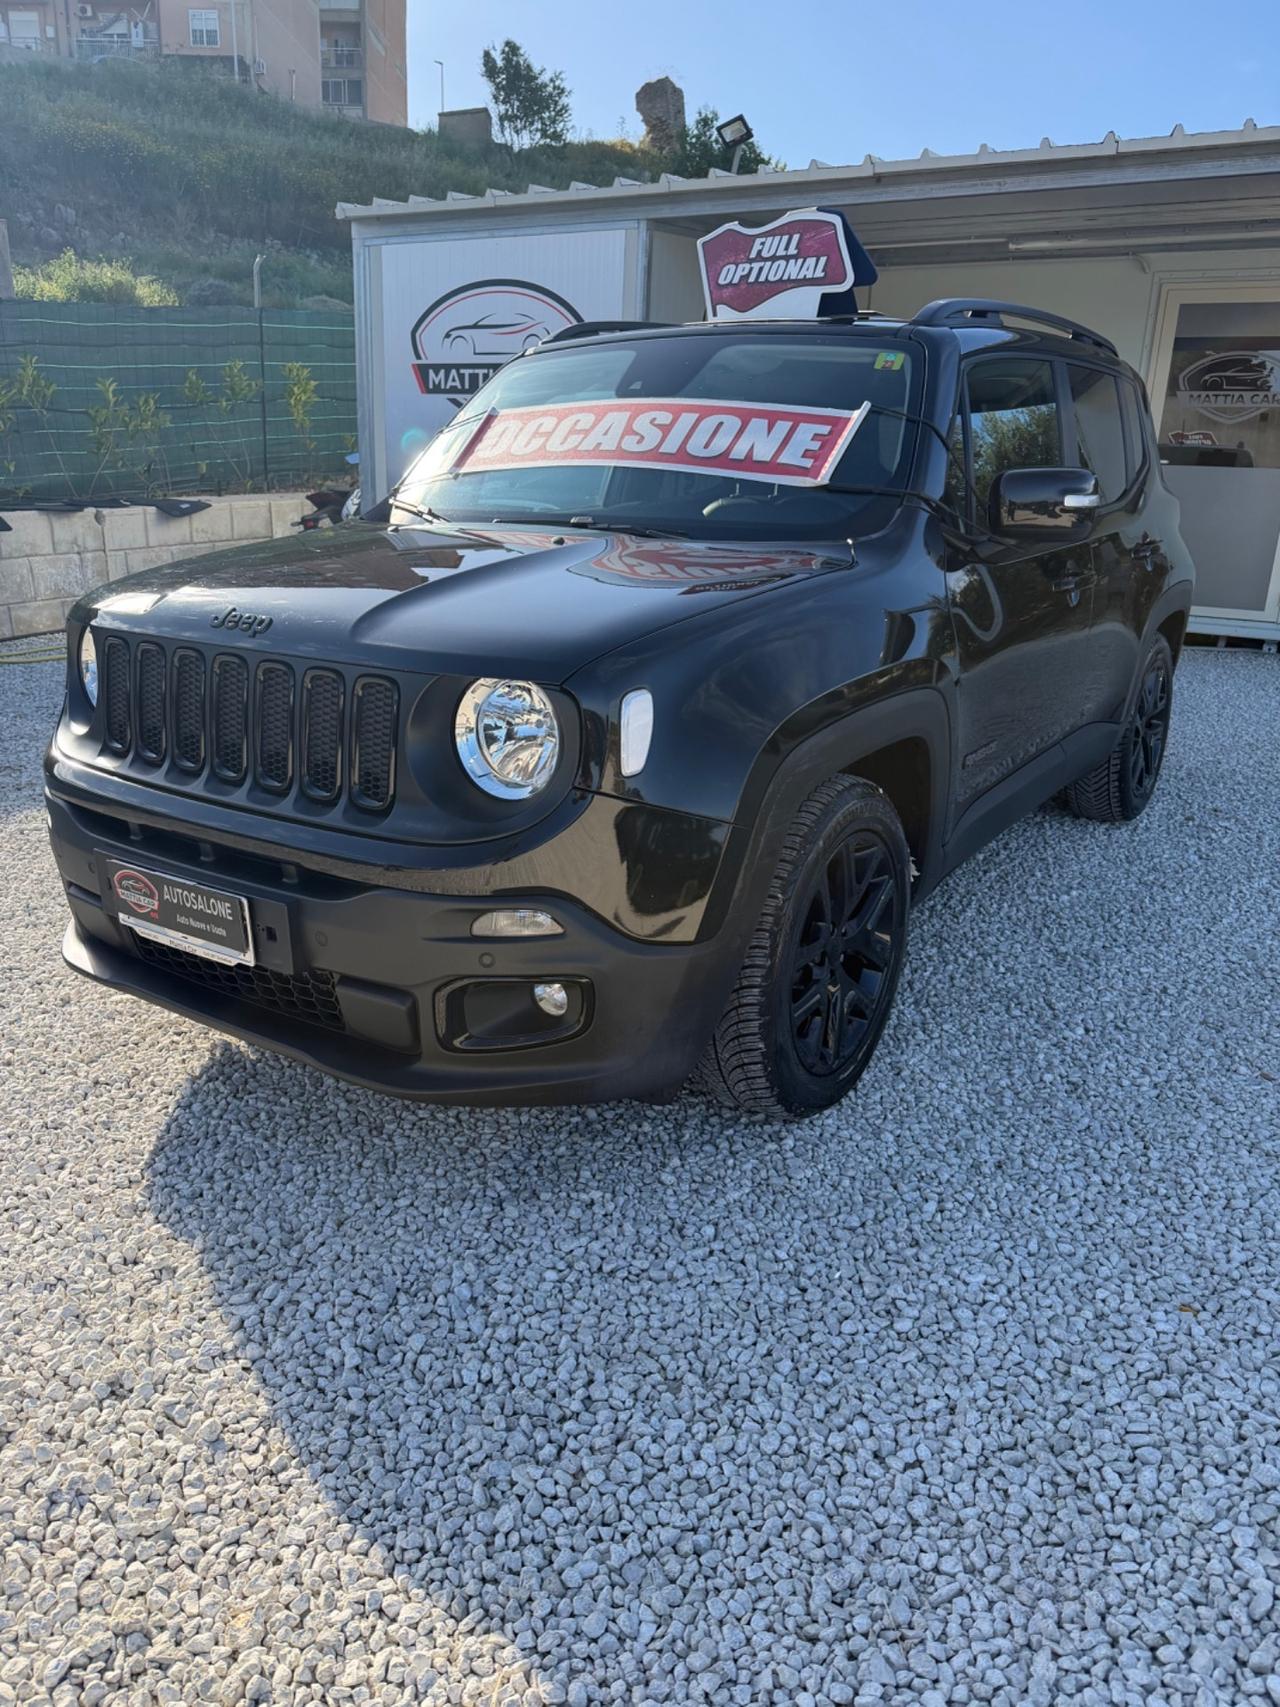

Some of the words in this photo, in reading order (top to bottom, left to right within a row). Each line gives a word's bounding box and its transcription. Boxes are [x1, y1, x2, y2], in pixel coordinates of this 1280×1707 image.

[749, 233, 801, 259] FULL
[717, 256, 828, 286] OPTIONAL
[1189, 393, 1245, 405] MATTIA
[474, 410, 833, 470] OCCASIONE
[209, 605, 274, 639] Jeep
[163, 884, 233, 921] AUTOSALONE
